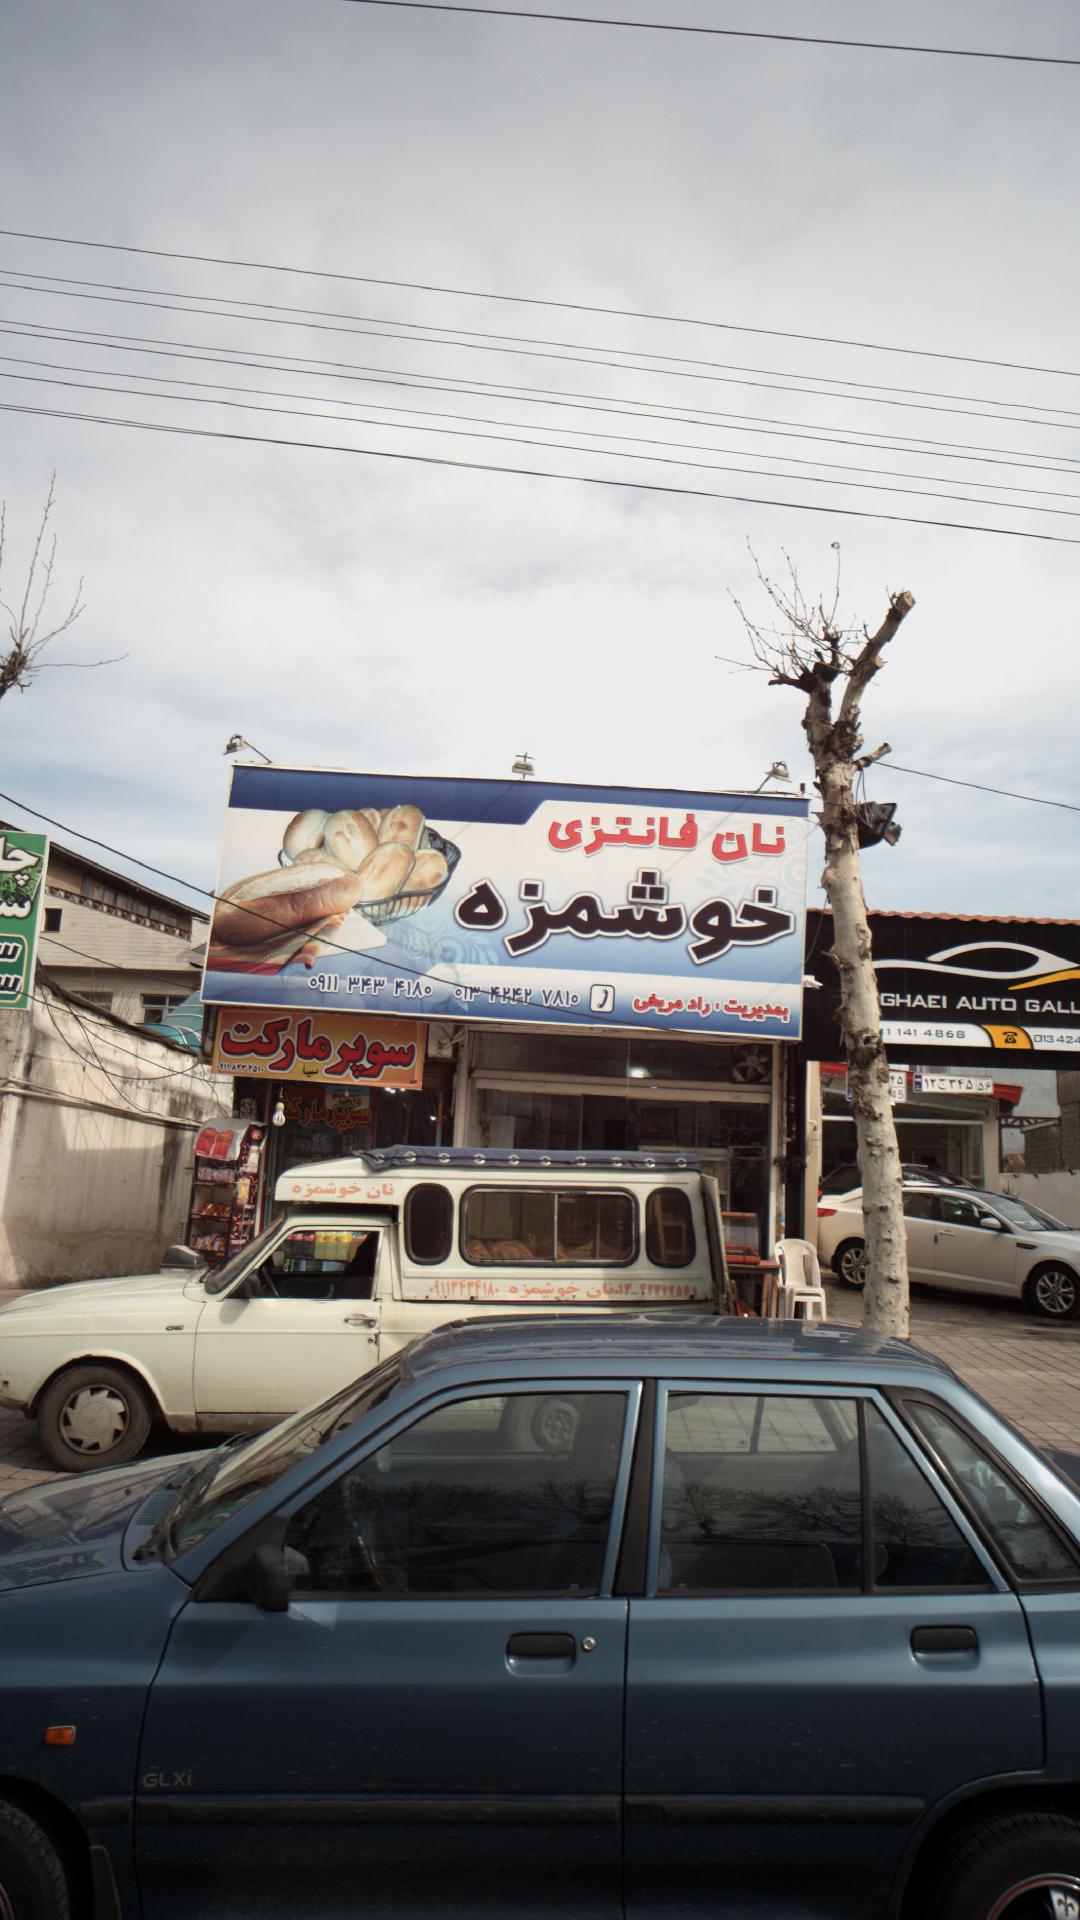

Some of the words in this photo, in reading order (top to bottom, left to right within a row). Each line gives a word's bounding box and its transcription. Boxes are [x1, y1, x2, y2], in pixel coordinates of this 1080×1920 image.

[547, 813, 699, 855] فانتزی
[712, 822, 787, 862] نان
[456, 869, 796, 964] خوشمزه
[309, 974, 338, 991] ۰۹۱۱
[348, 976, 386, 995] ۳۴۳
[394, 979, 432, 997] ۴۱۸۰
[542, 989, 580, 1006] ۷۸۱۰
[880, 993, 947, 1009] GHAEI
[956, 996, 1017, 1012] AUTO
[1025, 999, 1080, 1014] GALL
[222, 1018, 331, 1070] مارکت
[325, 1036, 416, 1078] سوپر
[292, 1182, 362, 1199] خوشمزه
[366, 1183, 394, 1199] نان
[508, 1281, 580, 1298] خوشمزه
